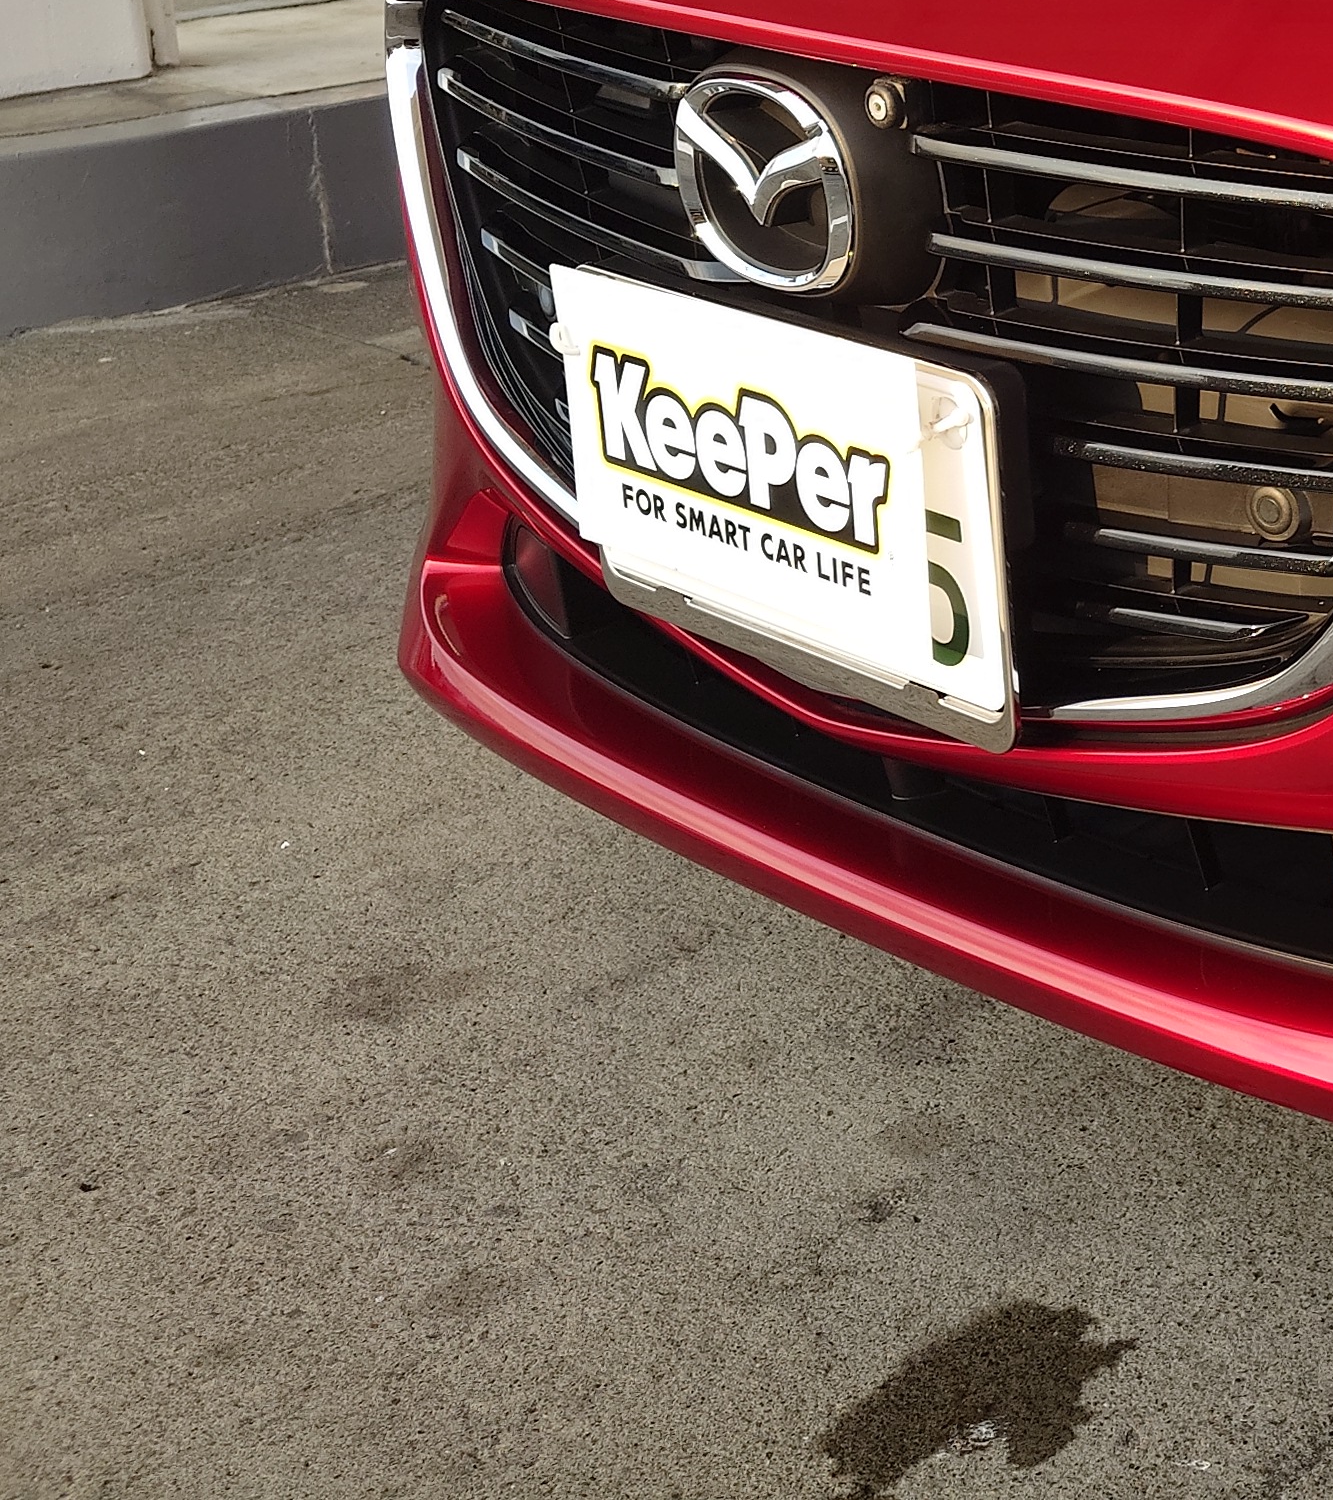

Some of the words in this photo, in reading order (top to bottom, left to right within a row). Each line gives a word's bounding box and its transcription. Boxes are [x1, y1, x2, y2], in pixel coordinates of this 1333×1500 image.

[592, 348, 889, 550] KeePer
[621, 483, 668, 524] FOR
[675, 500, 751, 553] SMART
[760, 532, 808, 575] CAR
[816, 550, 873, 597] LIFE
